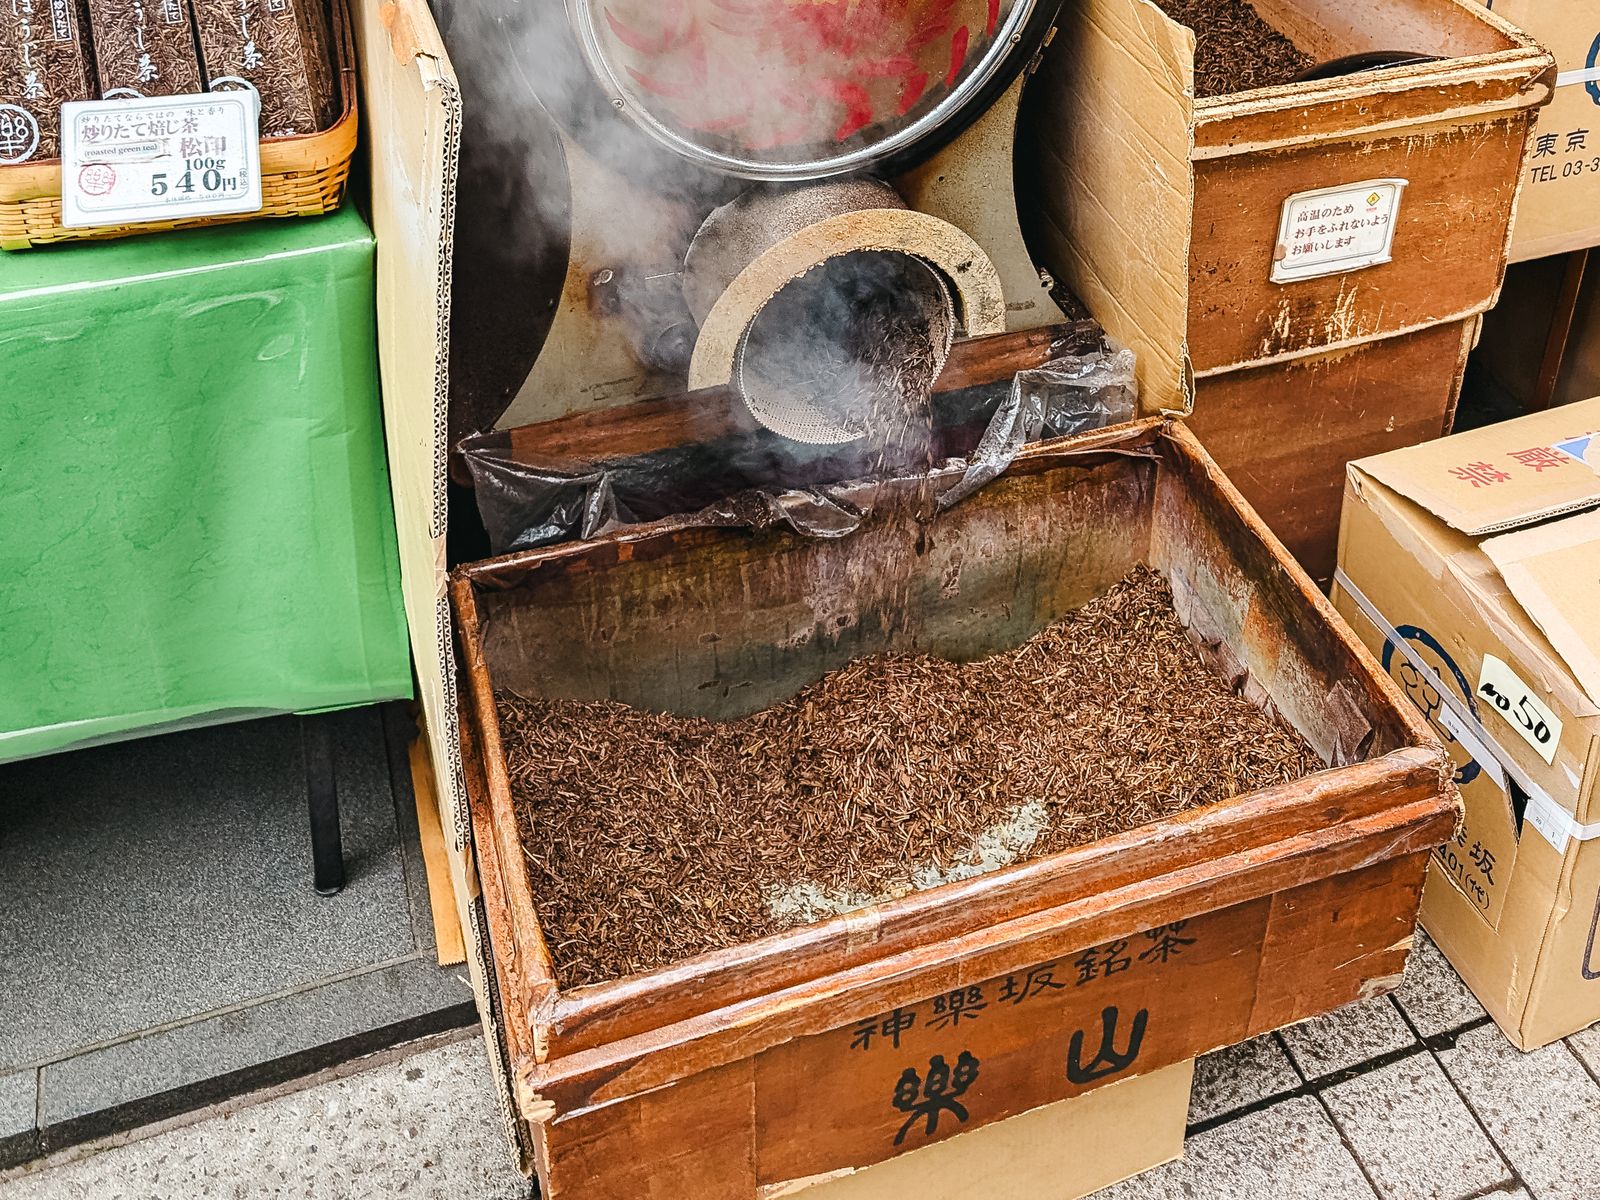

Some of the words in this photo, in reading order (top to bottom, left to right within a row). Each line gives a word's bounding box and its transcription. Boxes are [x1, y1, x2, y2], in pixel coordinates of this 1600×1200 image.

[81, 117, 199, 141] 炒りたて焙じ茶
[118, 145, 141, 157] green
[1532, 128, 1590, 159] 東京
[185, 157, 227, 171] 100g
[1531, 164, 1557, 184] TEL
[151, 169, 237, 196] 540円
[1297, 204, 1355, 223] 高温のため
[1294, 213, 1390, 239] お手をふれないよう
[1291, 235, 1357, 256] お願いします
[1448, 447, 1570, 488] 厳禁
